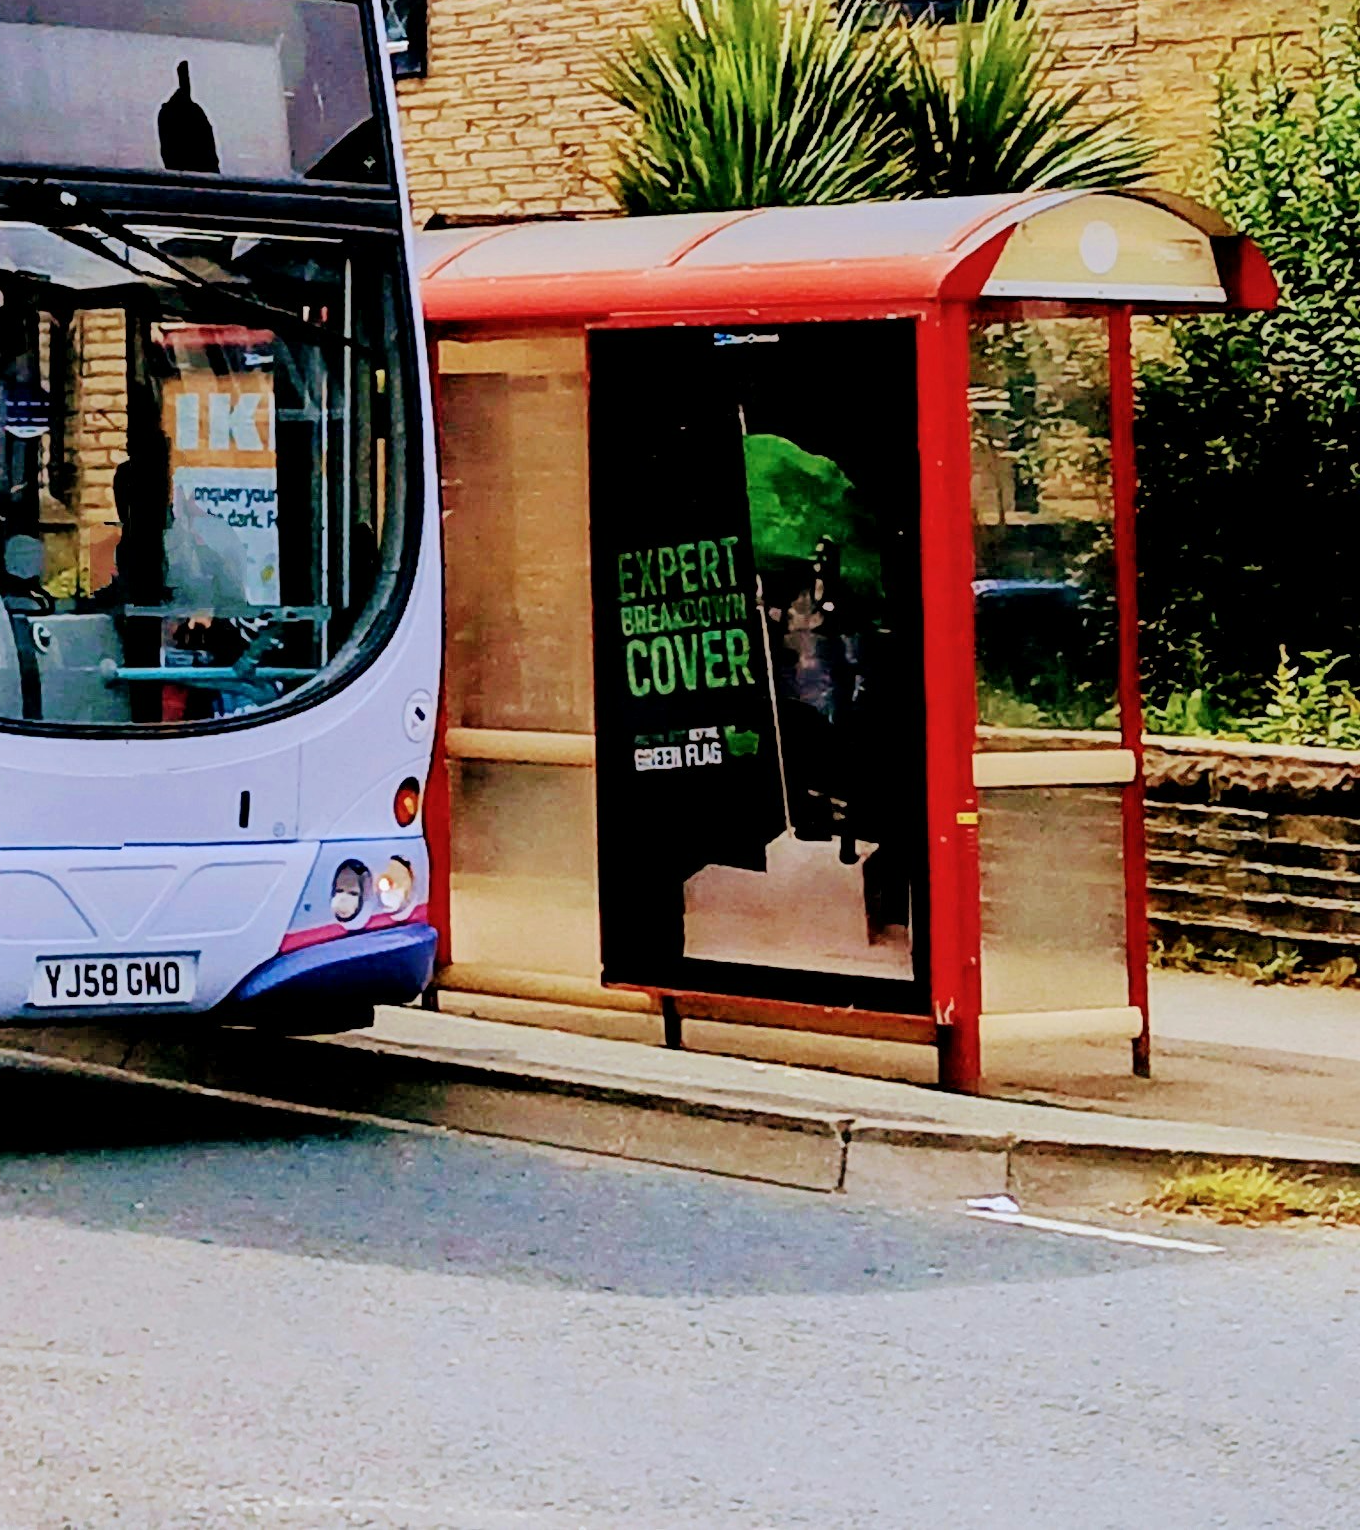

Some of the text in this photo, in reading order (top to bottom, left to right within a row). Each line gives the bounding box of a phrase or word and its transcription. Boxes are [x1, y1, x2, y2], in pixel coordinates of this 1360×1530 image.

[618, 536, 738, 602] EXPERT
[621, 592, 747, 636] BREAKDOWN
[627, 629, 756, 697] COVER
[45, 964, 118, 998] YJ58
